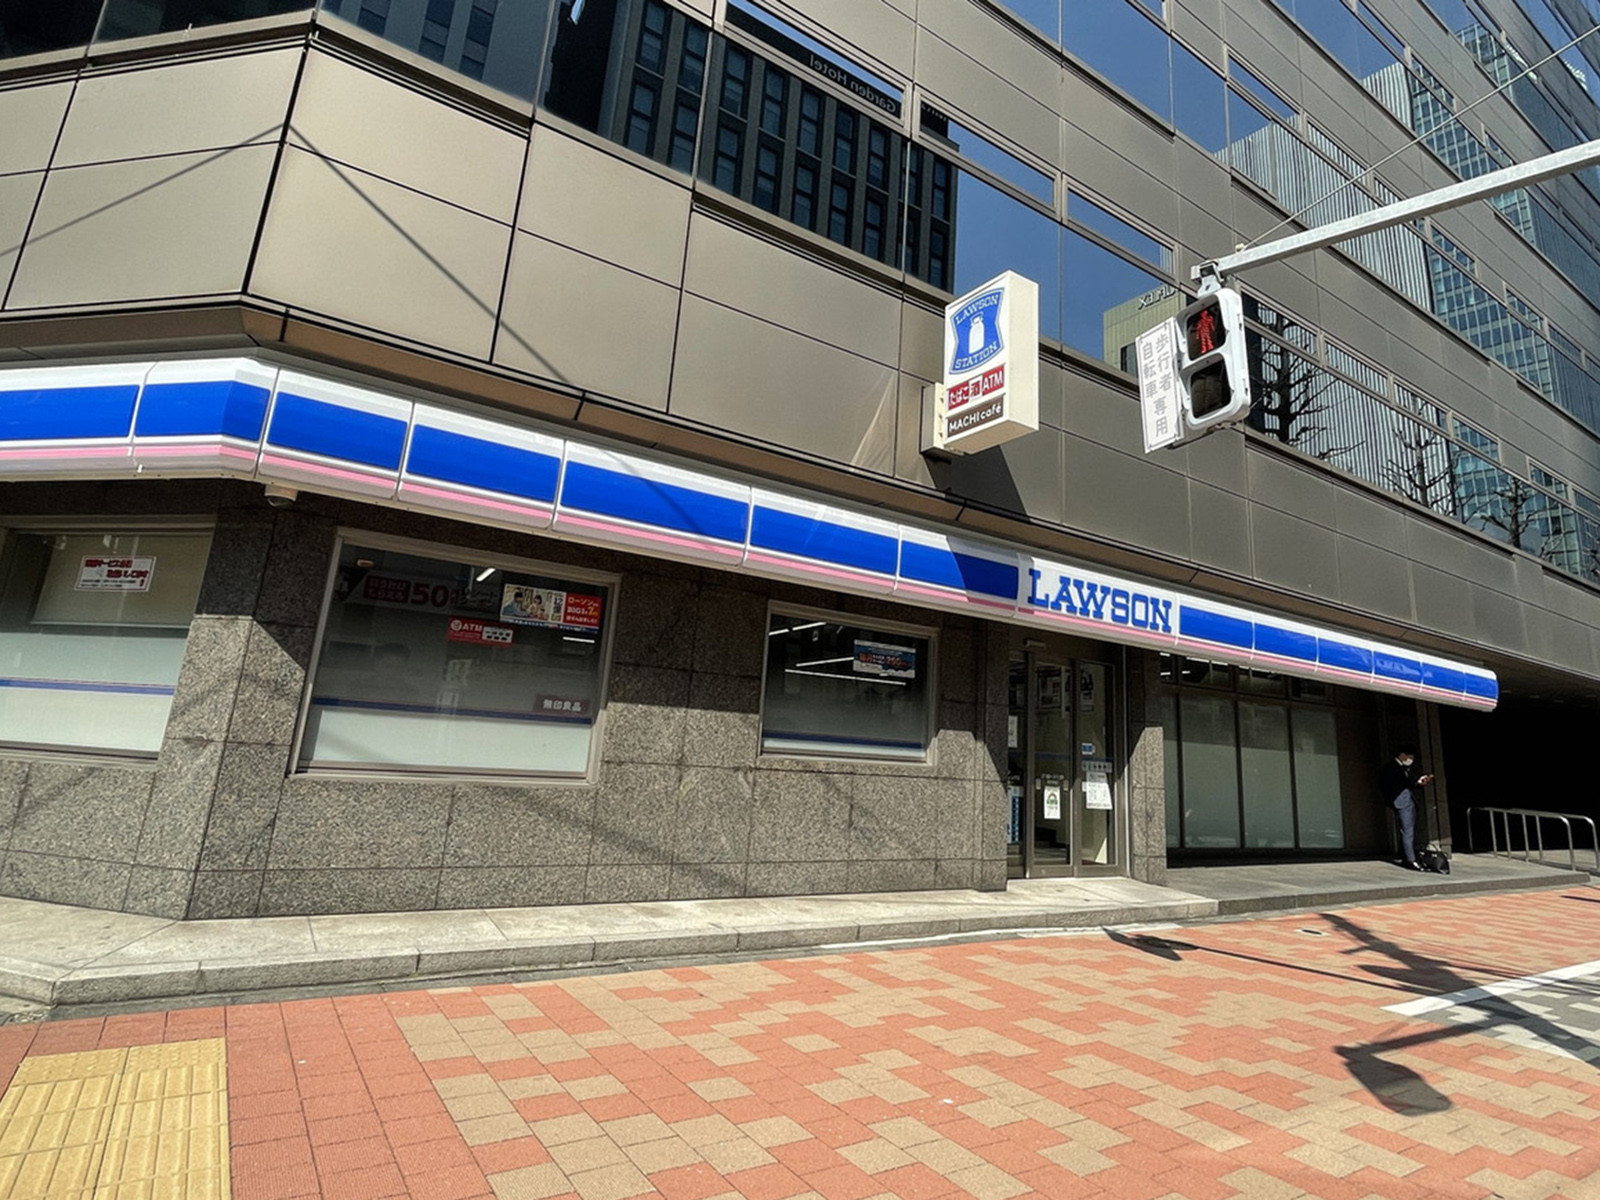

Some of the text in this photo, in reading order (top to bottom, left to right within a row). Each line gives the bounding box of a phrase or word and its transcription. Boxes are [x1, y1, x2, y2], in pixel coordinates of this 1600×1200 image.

[955, 293, 999, 326] LAWSON
[954, 341, 999, 370] STATION
[1142, 341, 1158, 399] 自転車
[1155, 334, 1173, 392] 歩行者
[983, 370, 1004, 392] ATM
[1153, 396, 1170, 438] 専用
[1027, 568, 1173, 633] LAWSON
[543, 699, 582, 712] 無印良品
